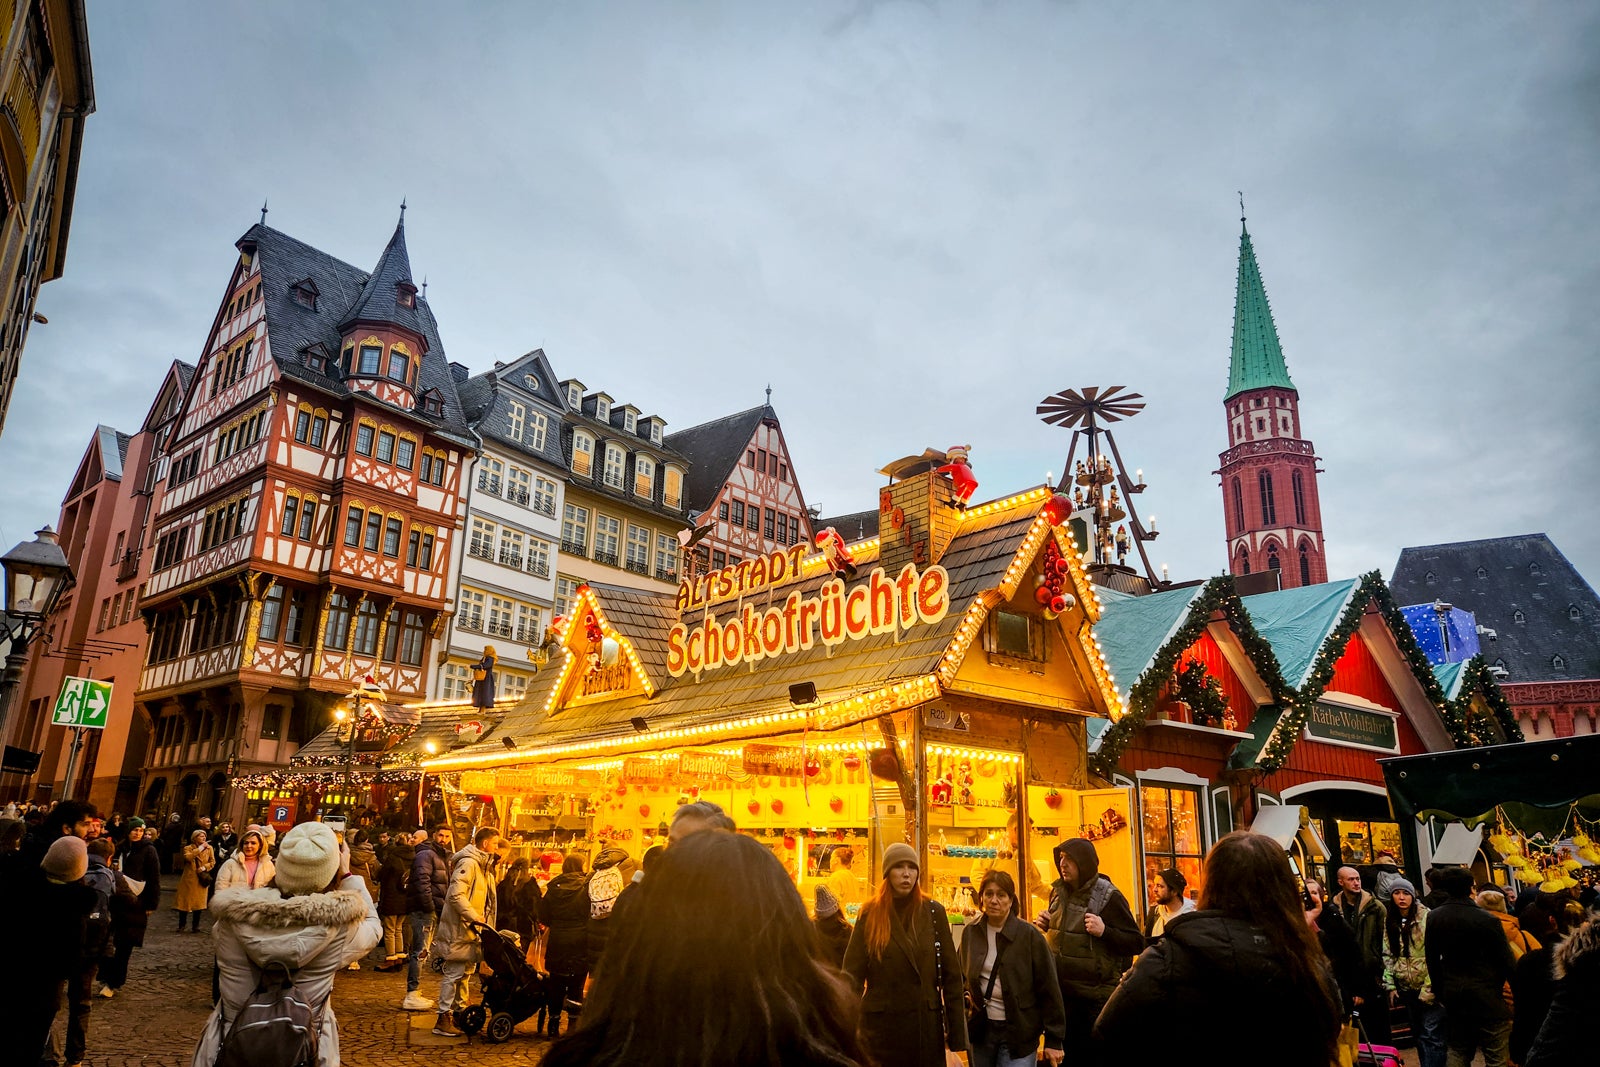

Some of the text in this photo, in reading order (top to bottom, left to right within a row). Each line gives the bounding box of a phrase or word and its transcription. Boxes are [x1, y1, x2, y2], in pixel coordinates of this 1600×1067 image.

[675, 543, 808, 612] ALTSTADT
[667, 563, 950, 678] Schokofrüchte
[819, 683, 940, 730] Paradies Apfel
[930, 708, 946, 720] R20
[682, 755, 728, 776] Bananen
[277, 810, 286, 820] P
